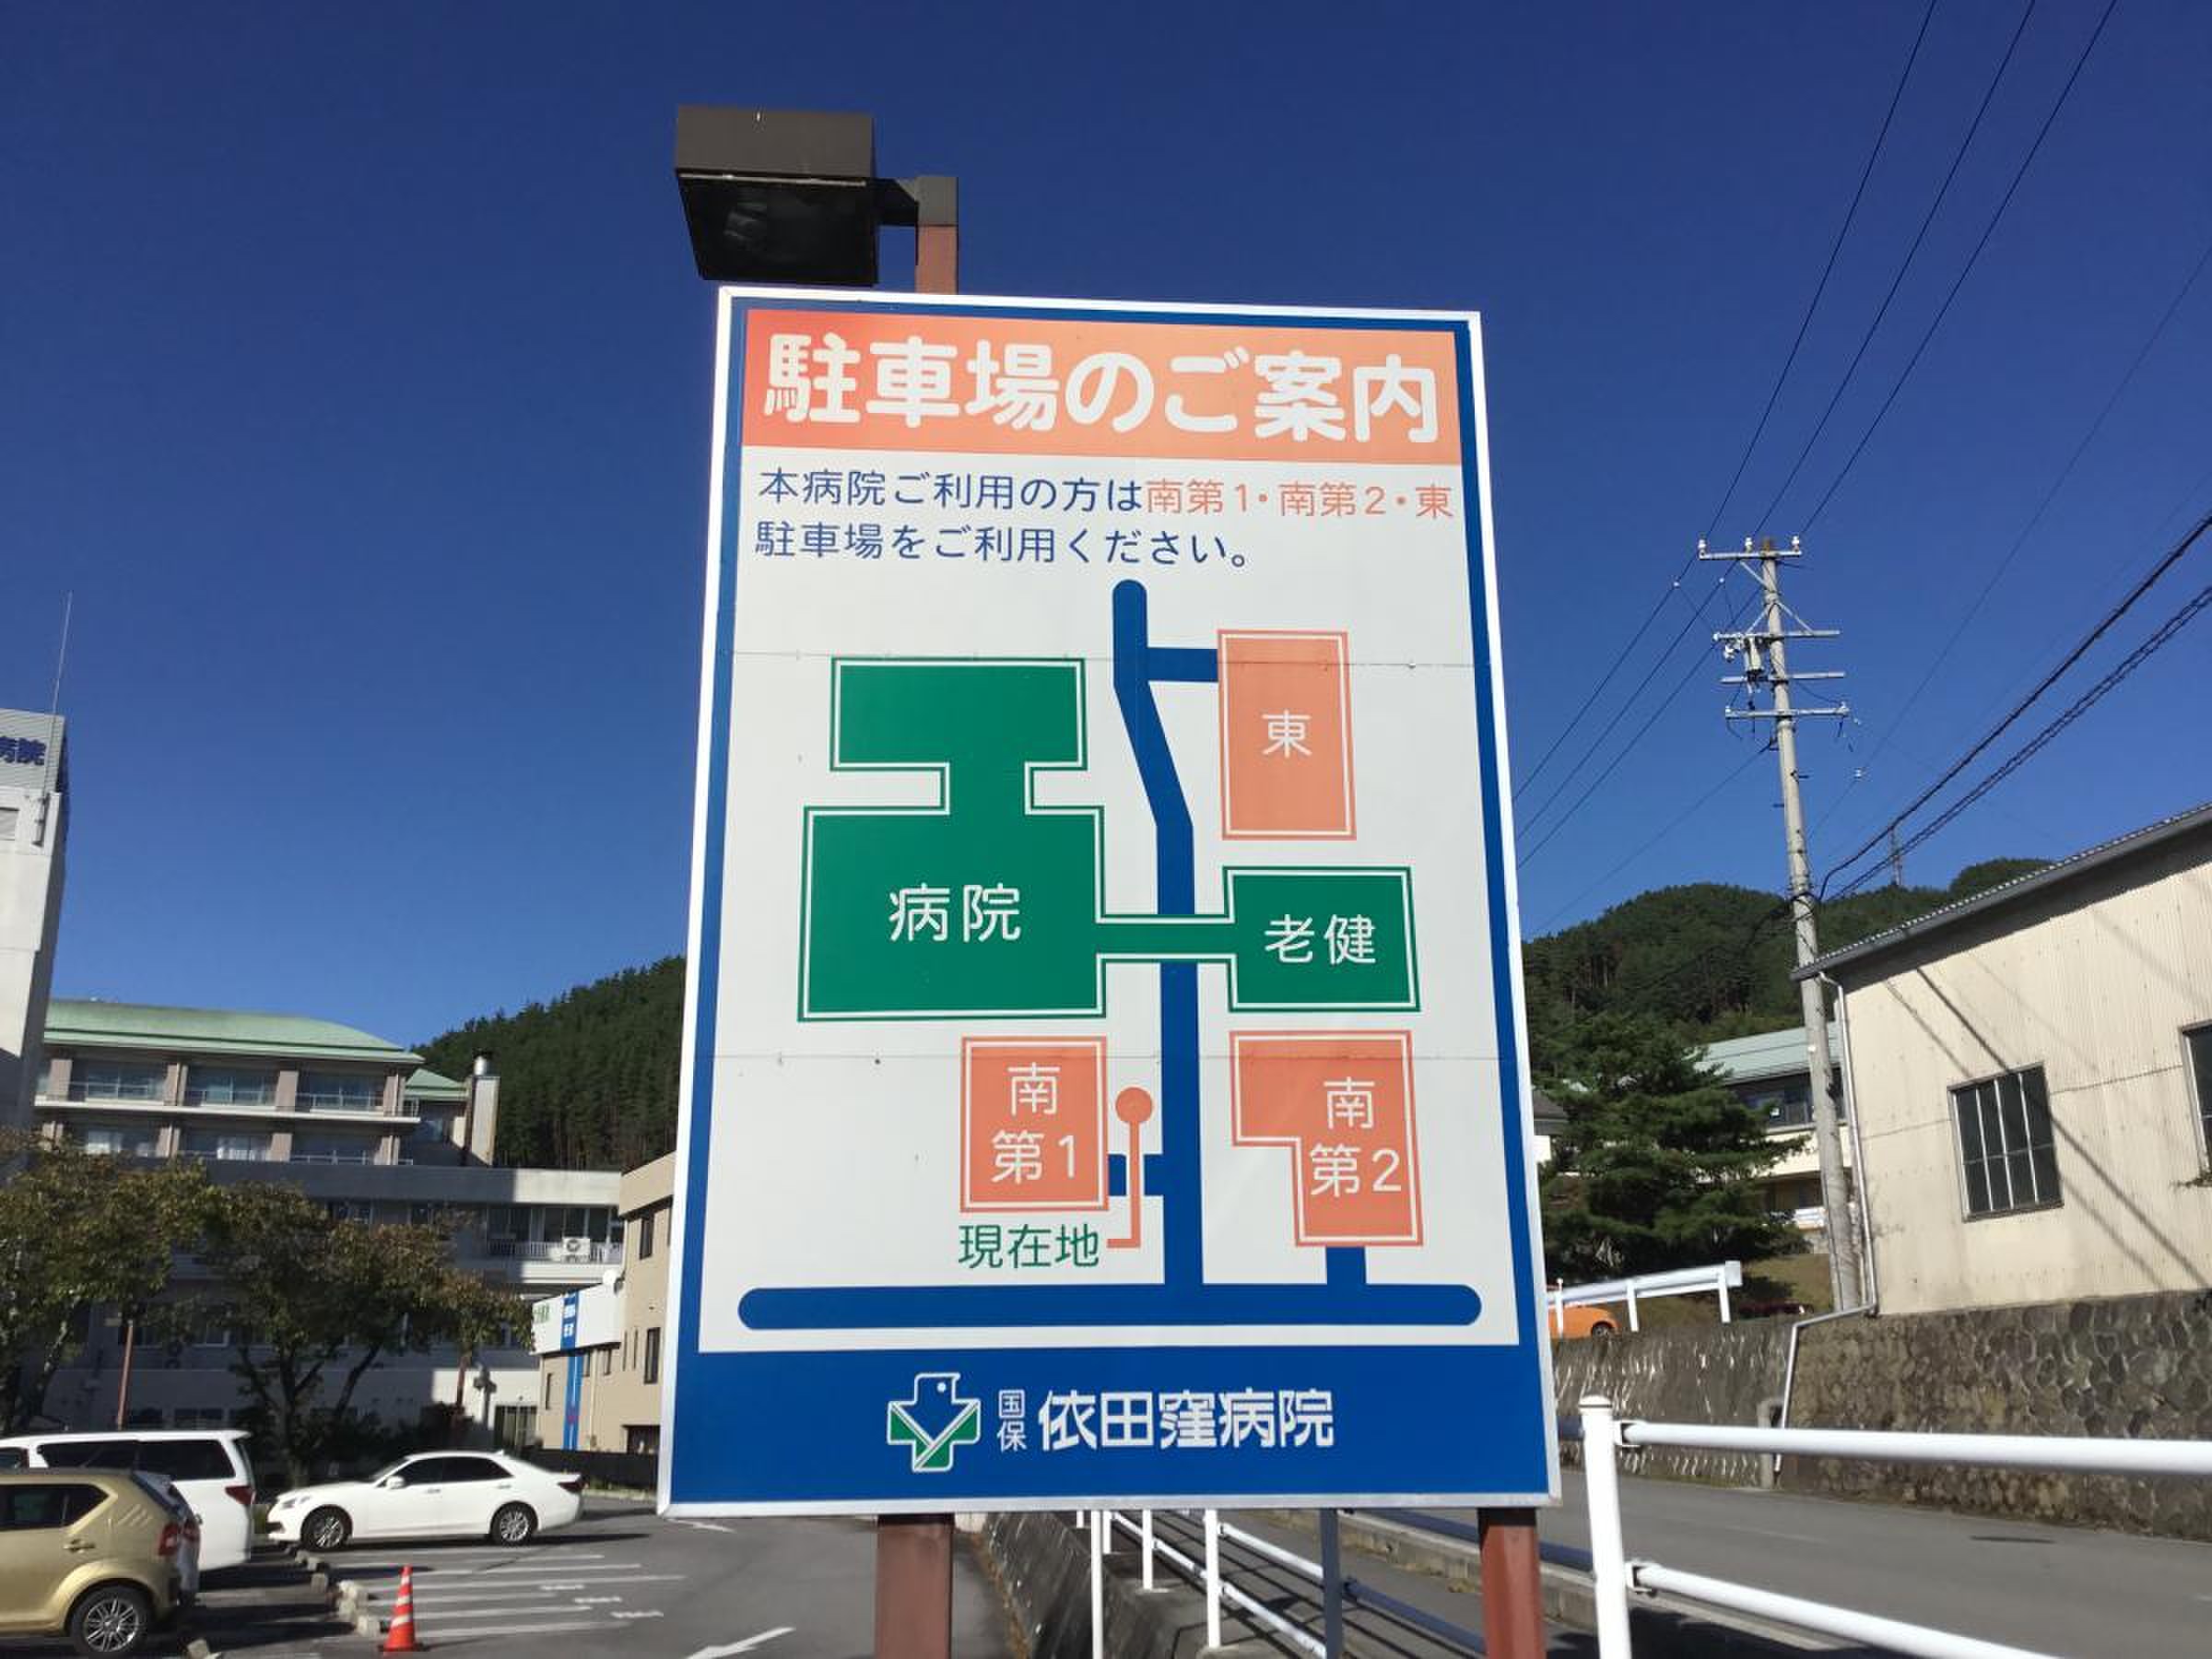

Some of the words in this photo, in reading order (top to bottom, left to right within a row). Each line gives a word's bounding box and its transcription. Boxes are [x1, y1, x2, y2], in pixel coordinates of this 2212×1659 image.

[762, 331, 1439, 443] 駐車場のご案内
[755, 521, 1250, 568] 駐車場をご利用ください。
[1262, 710, 1312, 758] 東
[888, 883, 1021, 942] 病院
[1264, 913, 1376, 965] 老健
[1006, 1062, 1060, 1116] 南
[1324, 1076, 1375, 1130] 南
[991, 1130, 1077, 1183] 第1
[1309, 1143, 1403, 1197] 第2
[958, 1223, 1100, 1269] 現在地
[996, 1388, 1027, 1452] 国保
[1038, 1387, 1334, 1452] 依田窪病院
